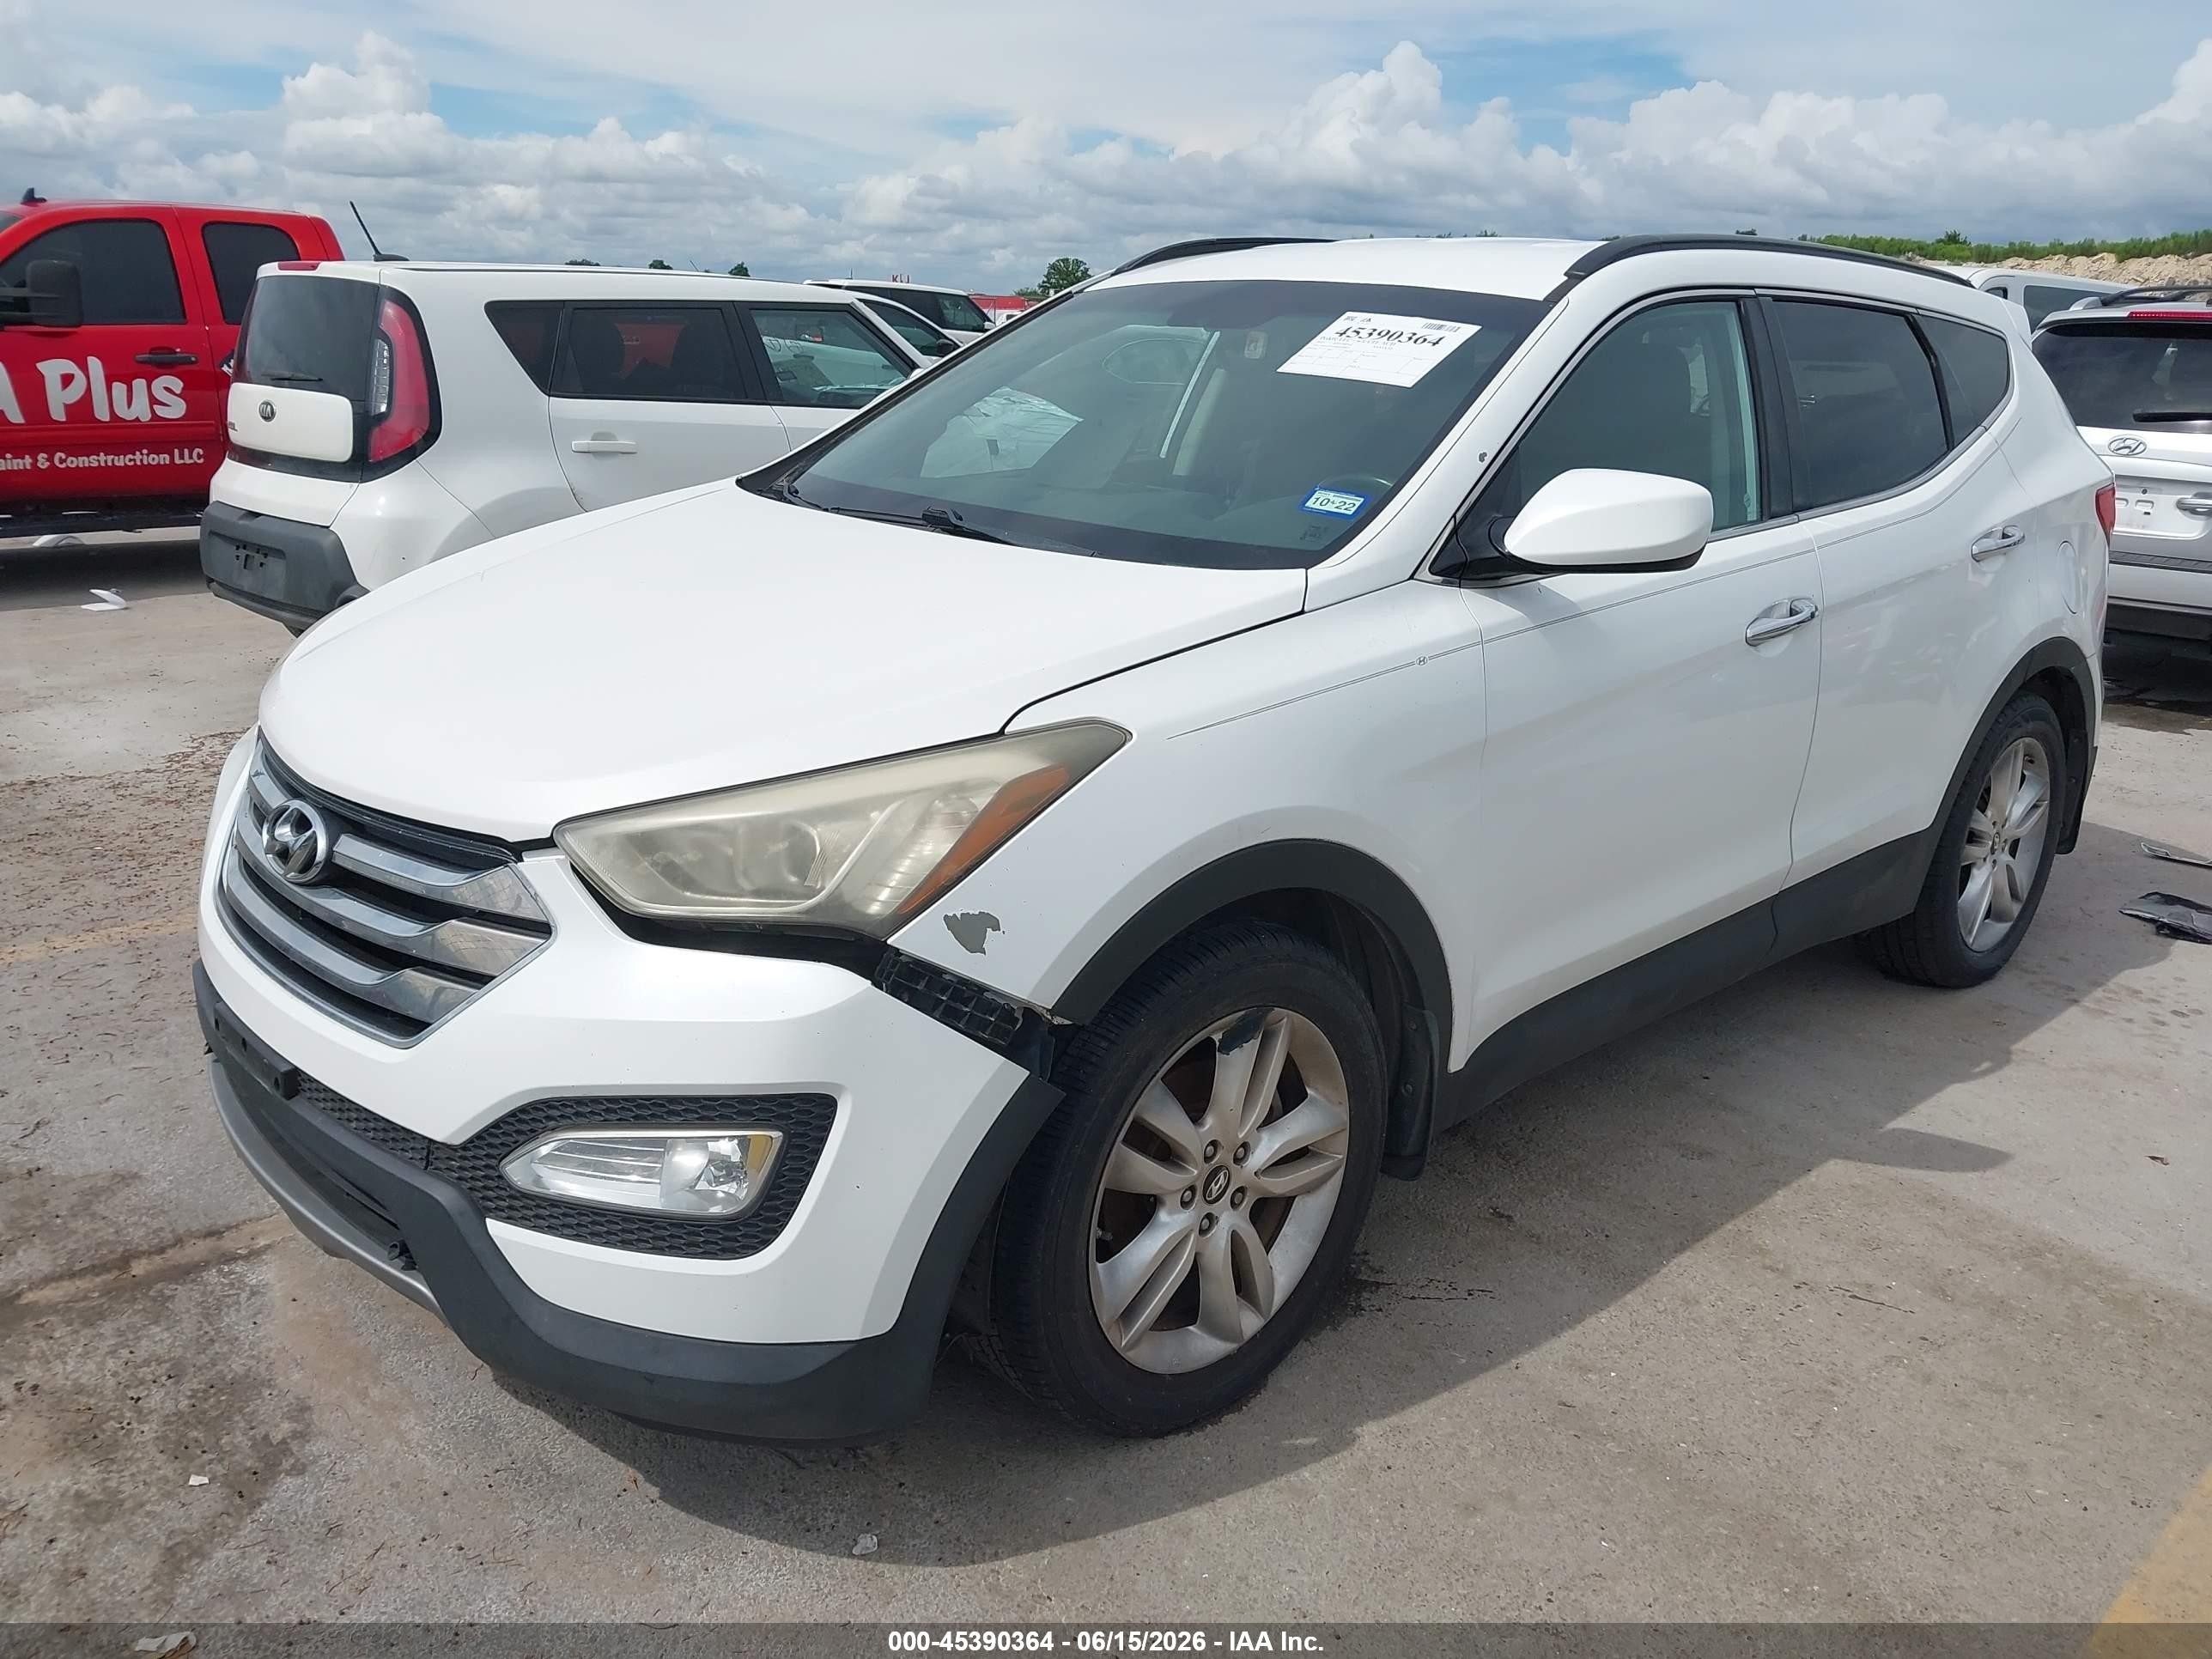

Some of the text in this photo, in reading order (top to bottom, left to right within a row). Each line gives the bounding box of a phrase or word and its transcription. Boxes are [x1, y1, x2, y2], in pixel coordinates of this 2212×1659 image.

[1335, 326, 1446, 347] 45390364
[35, 356, 187, 422] Plus
[37, 453, 50, 469] &
[54, 449, 170, 468] Construction
[173, 447, 204, 465] LLC
